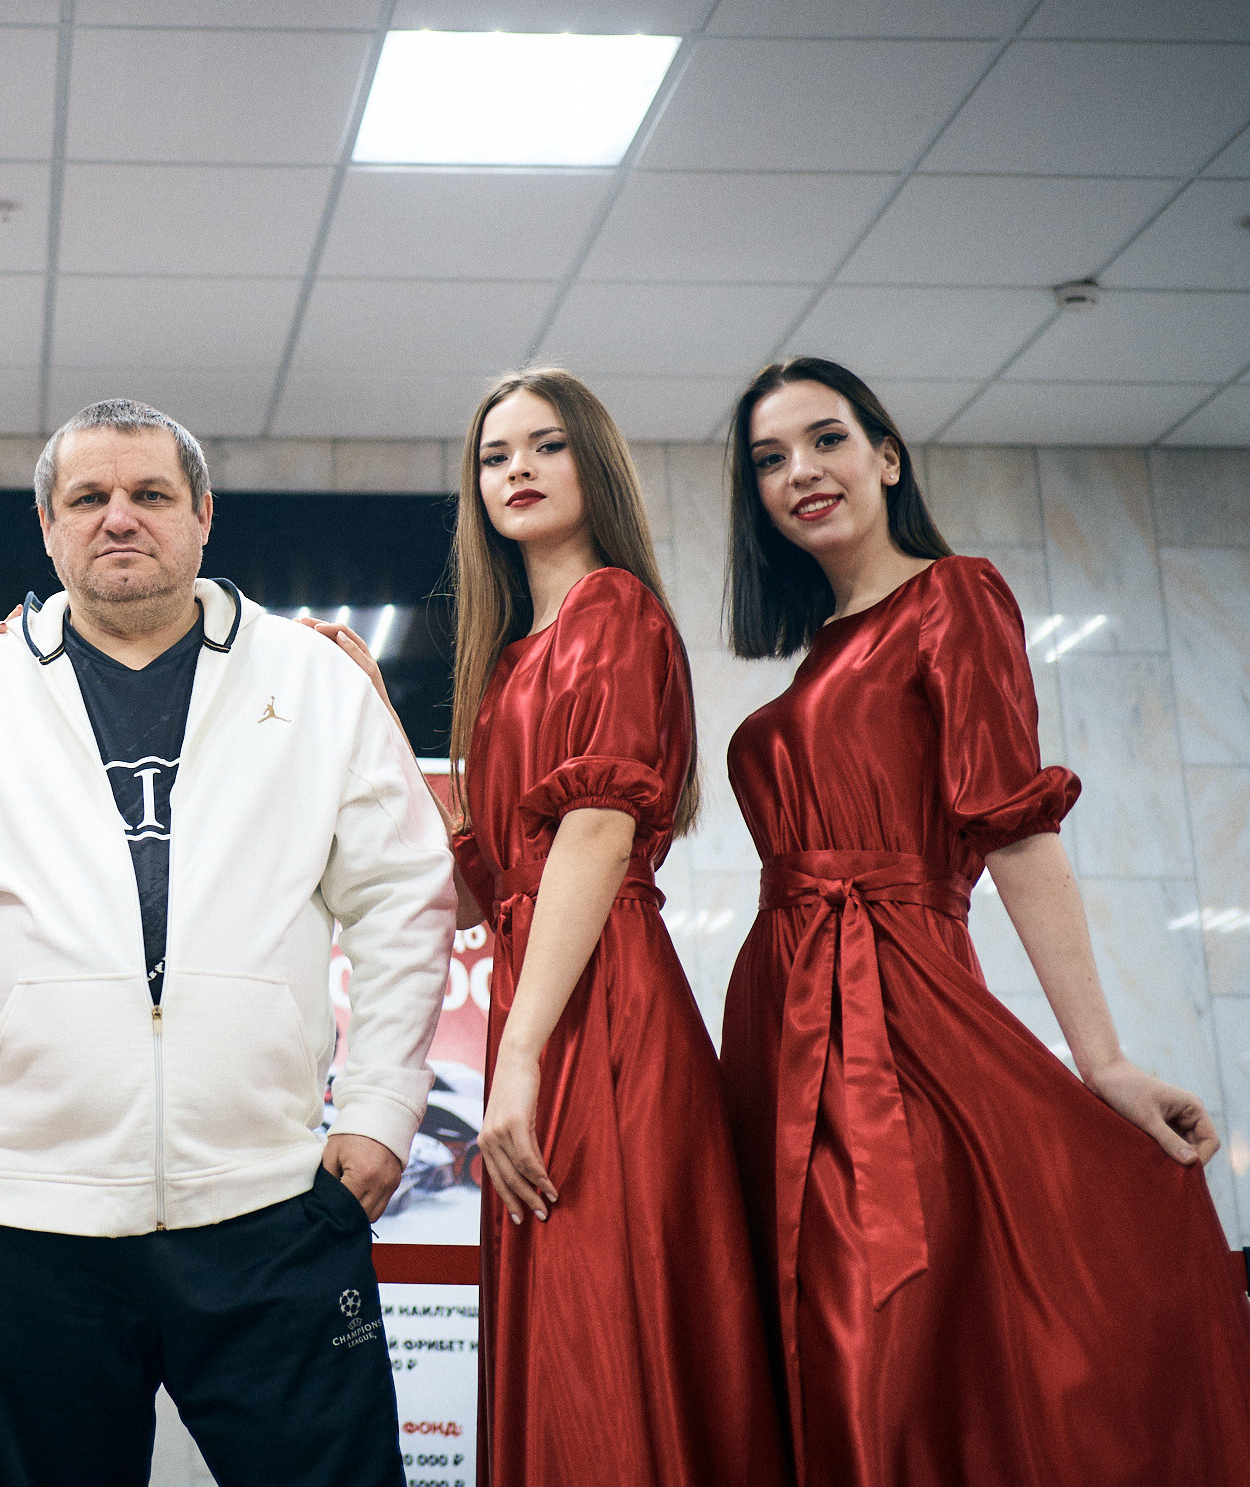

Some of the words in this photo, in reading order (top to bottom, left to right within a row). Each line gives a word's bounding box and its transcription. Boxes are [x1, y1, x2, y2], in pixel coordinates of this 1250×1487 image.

[332, 1319, 382, 1346] CHAMPIONS
[403, 1339, 464, 1352] ФРИБЕТ
[403, 1421, 463, 1437] ФОНД:
